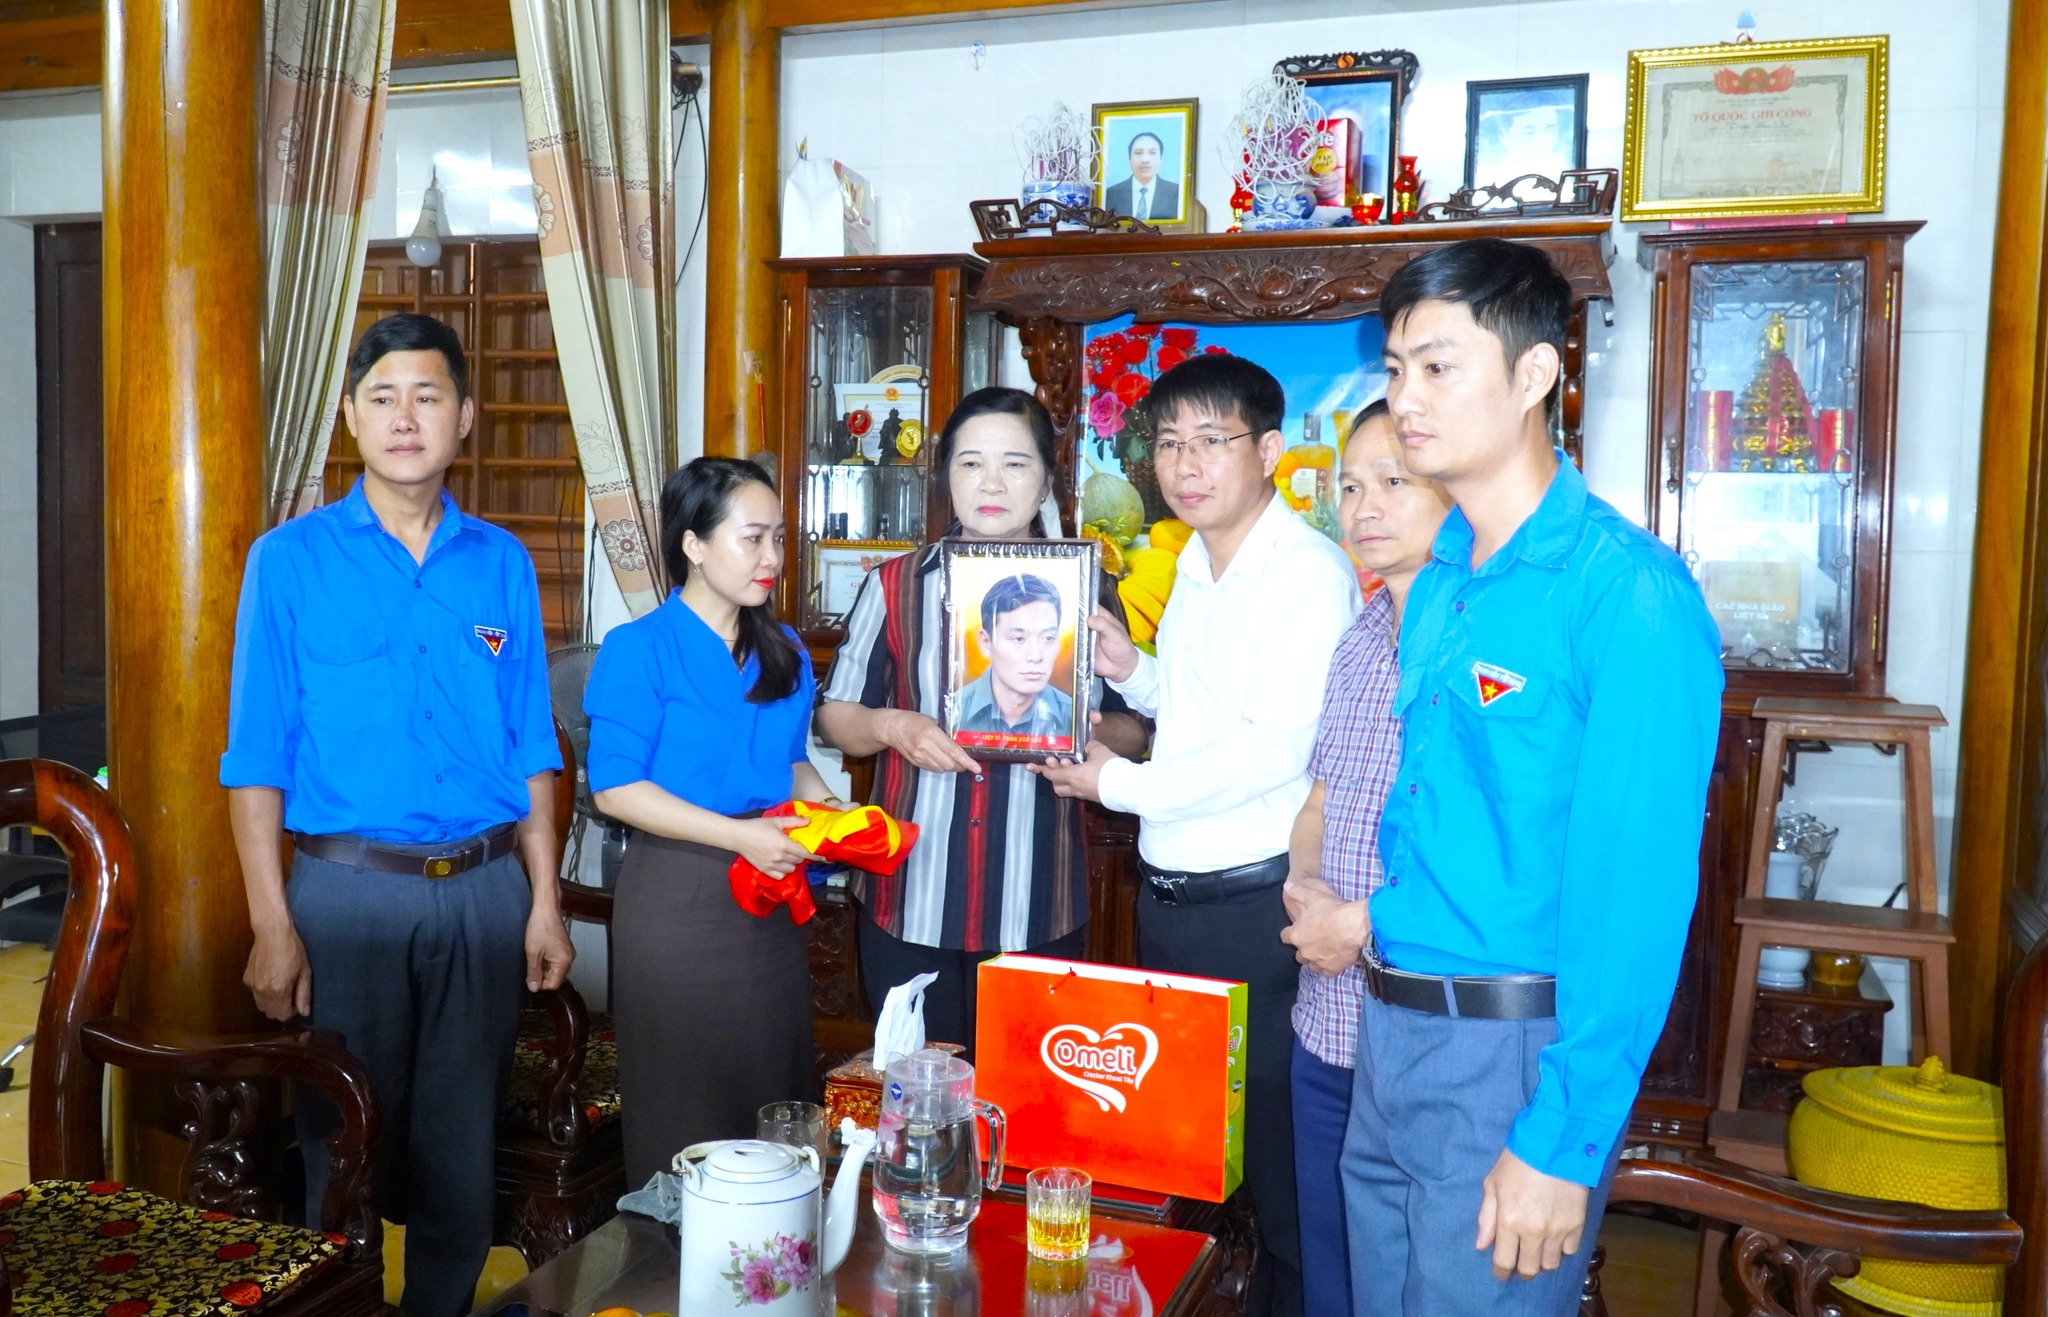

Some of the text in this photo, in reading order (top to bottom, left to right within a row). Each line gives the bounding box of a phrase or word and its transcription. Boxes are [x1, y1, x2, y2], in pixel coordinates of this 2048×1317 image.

[1751, 109, 1774, 119] GHI
[1776, 107, 1812, 118] CÔNG
[1054, 1038, 1137, 1076] Omeli
[1083, 1070, 1105, 1080] Cracker
